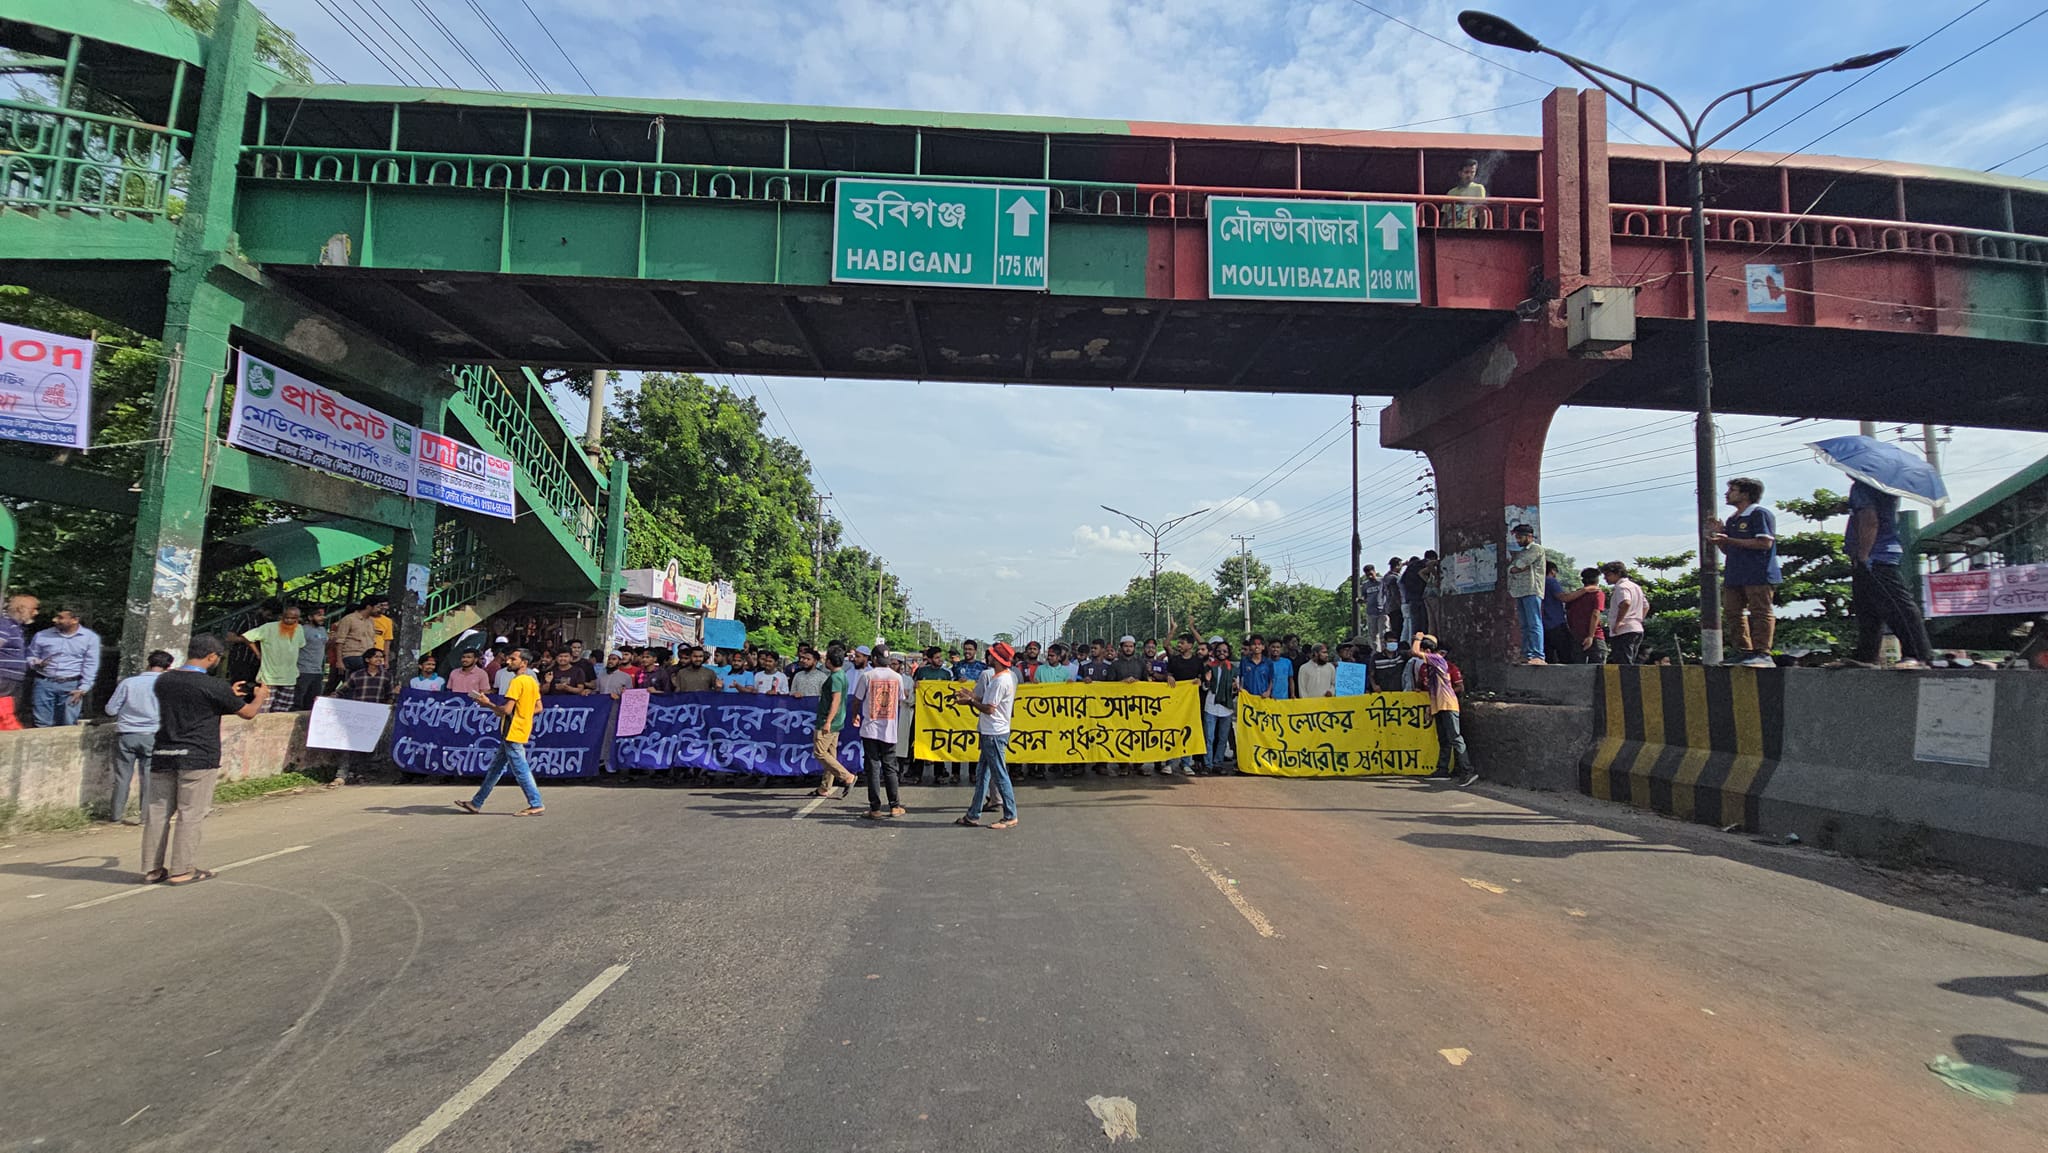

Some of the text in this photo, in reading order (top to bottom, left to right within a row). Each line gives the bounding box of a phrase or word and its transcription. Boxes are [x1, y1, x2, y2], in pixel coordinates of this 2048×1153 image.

[849, 191, 966, 229] হবিগঞ্জ
[1220, 206, 1359, 245] মৌলভীবাজার
[847, 248, 972, 274] HABIGANJ
[999, 255, 1043, 277] 175 KM
[1221, 264, 1361, 288] MOULVIBAZAR
[1370, 269, 1414, 290] 218 KM
[281, 385, 387, 439] প্রাইমেট
[422, 440, 485, 475] uniaid
[1026, 695, 1096, 719] তোমার
[1090, 695, 1170, 720] আমার
[1288, 709, 1355, 733] লোকের
[1253, 738, 1351, 772] কোটাধারীর
